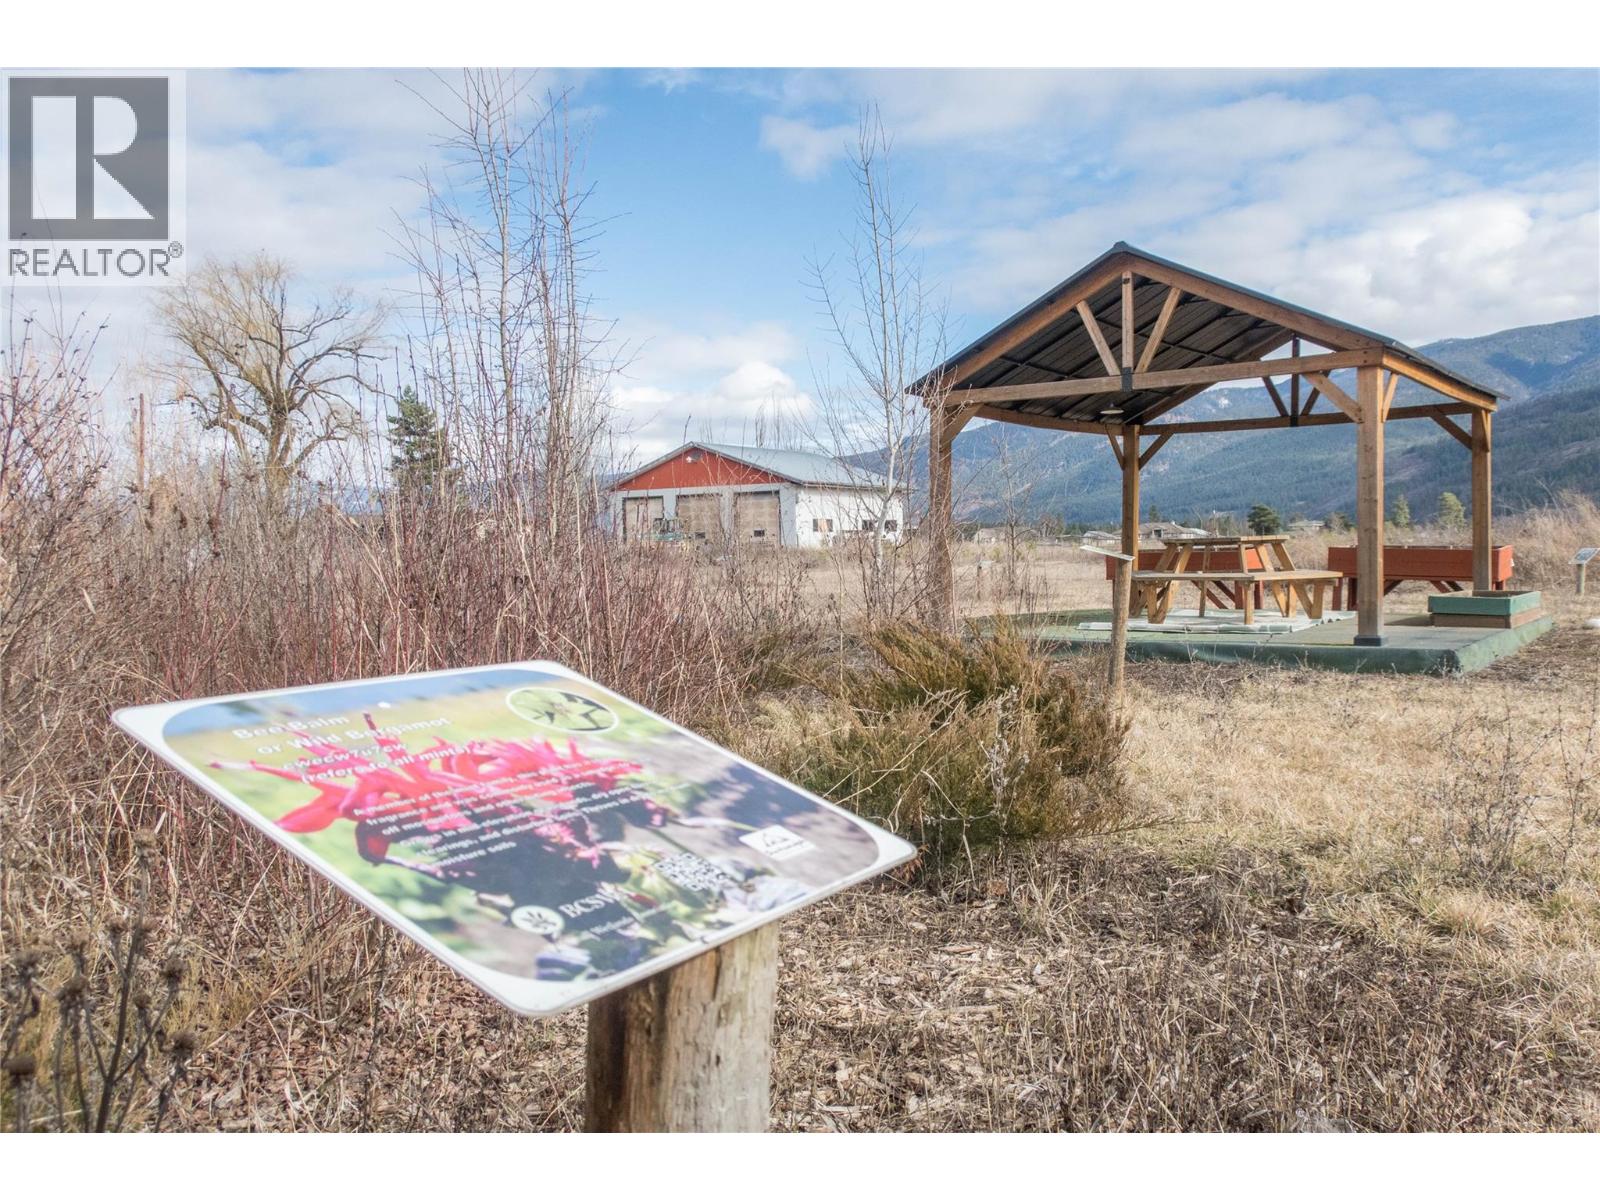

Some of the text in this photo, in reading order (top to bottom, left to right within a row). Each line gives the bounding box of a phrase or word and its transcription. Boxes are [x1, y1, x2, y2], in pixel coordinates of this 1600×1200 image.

[232, 715, 350, 741] Bee Balm
[257, 716, 451, 755] or Wild Bergamot
[393, 753, 415, 767] all
[368, 807, 426, 825] fragrance
